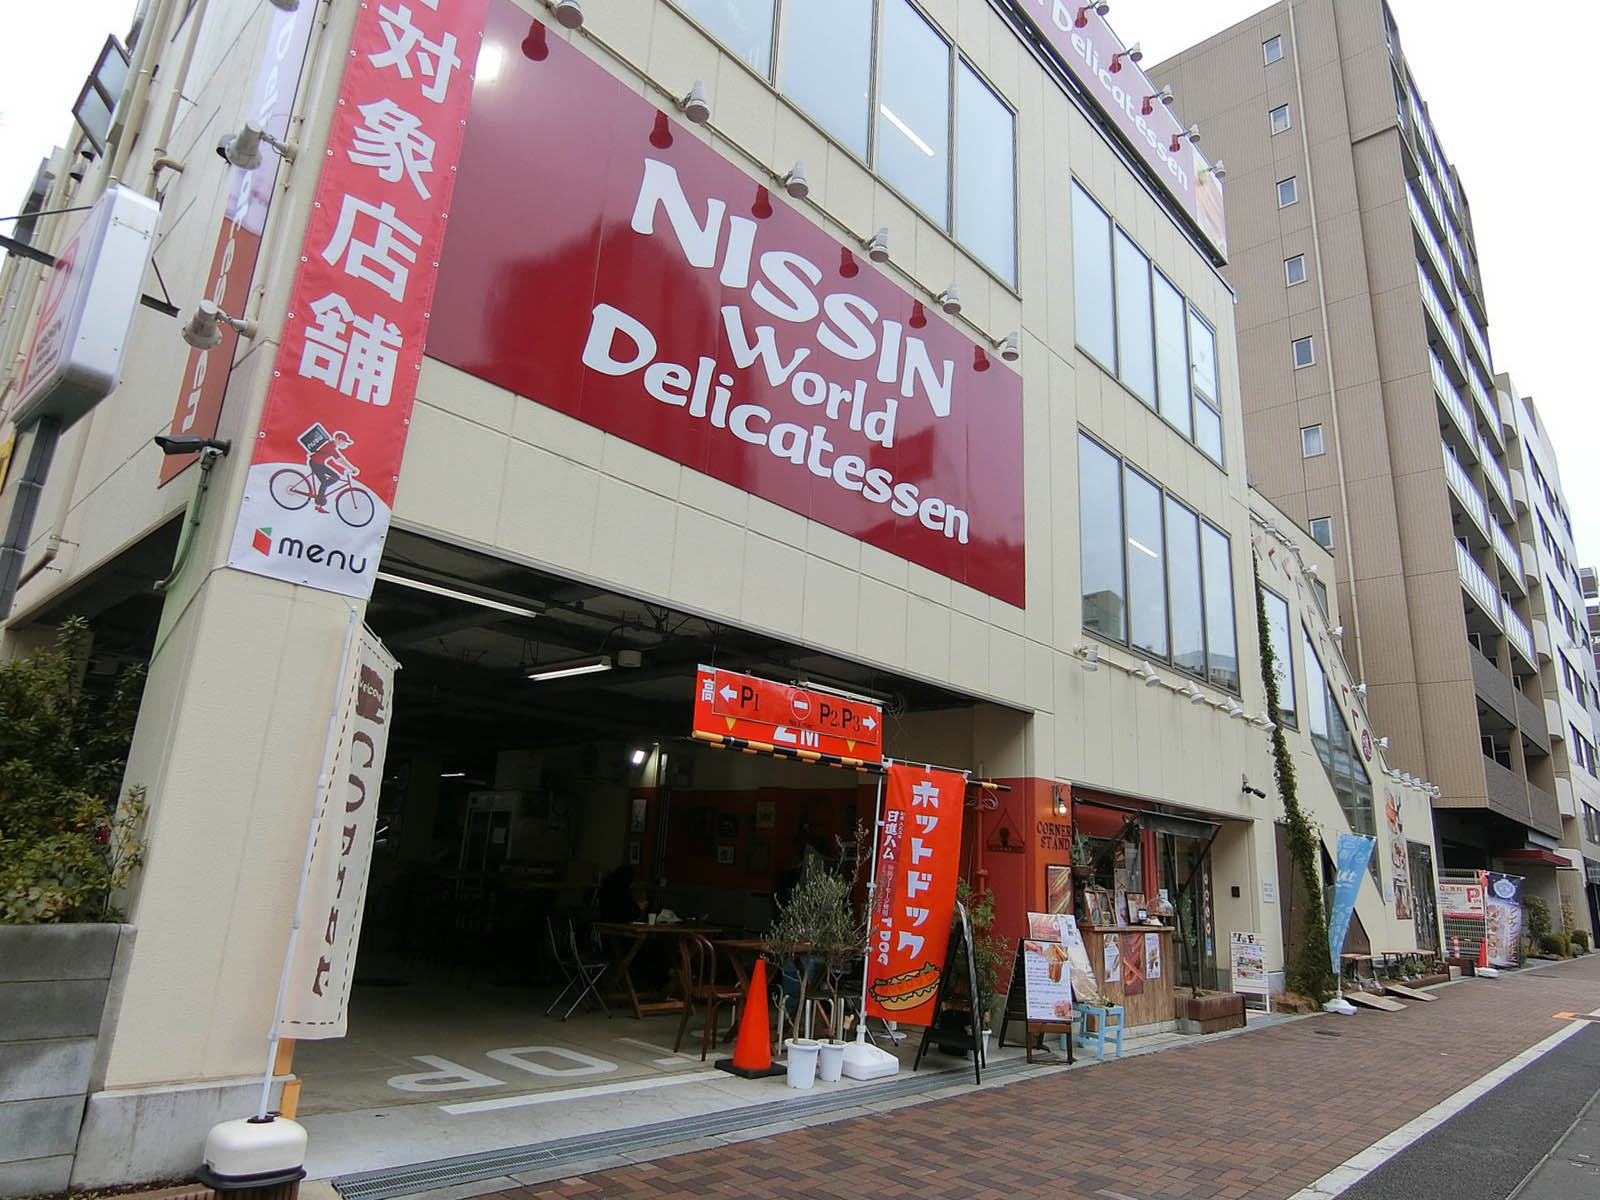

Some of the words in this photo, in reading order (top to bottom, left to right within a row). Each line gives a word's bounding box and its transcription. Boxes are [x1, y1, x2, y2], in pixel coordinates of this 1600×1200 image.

[1053, 0, 1188, 191] Delicatessen
[298, 0, 462, 407] 対象店舗
[631, 158, 955, 418] NISSIN
[582, 303, 970, 544] Delicatessen
[721, 305, 899, 448] World
[278, 537, 367, 574] menu
[740, 685, 760, 712] P1
[882, 810, 900, 860] 日進ハム
[897, 781, 940, 960] ホットドック
[1036, 821, 1072, 838] CORNER
[1040, 835, 1071, 851] STAND
